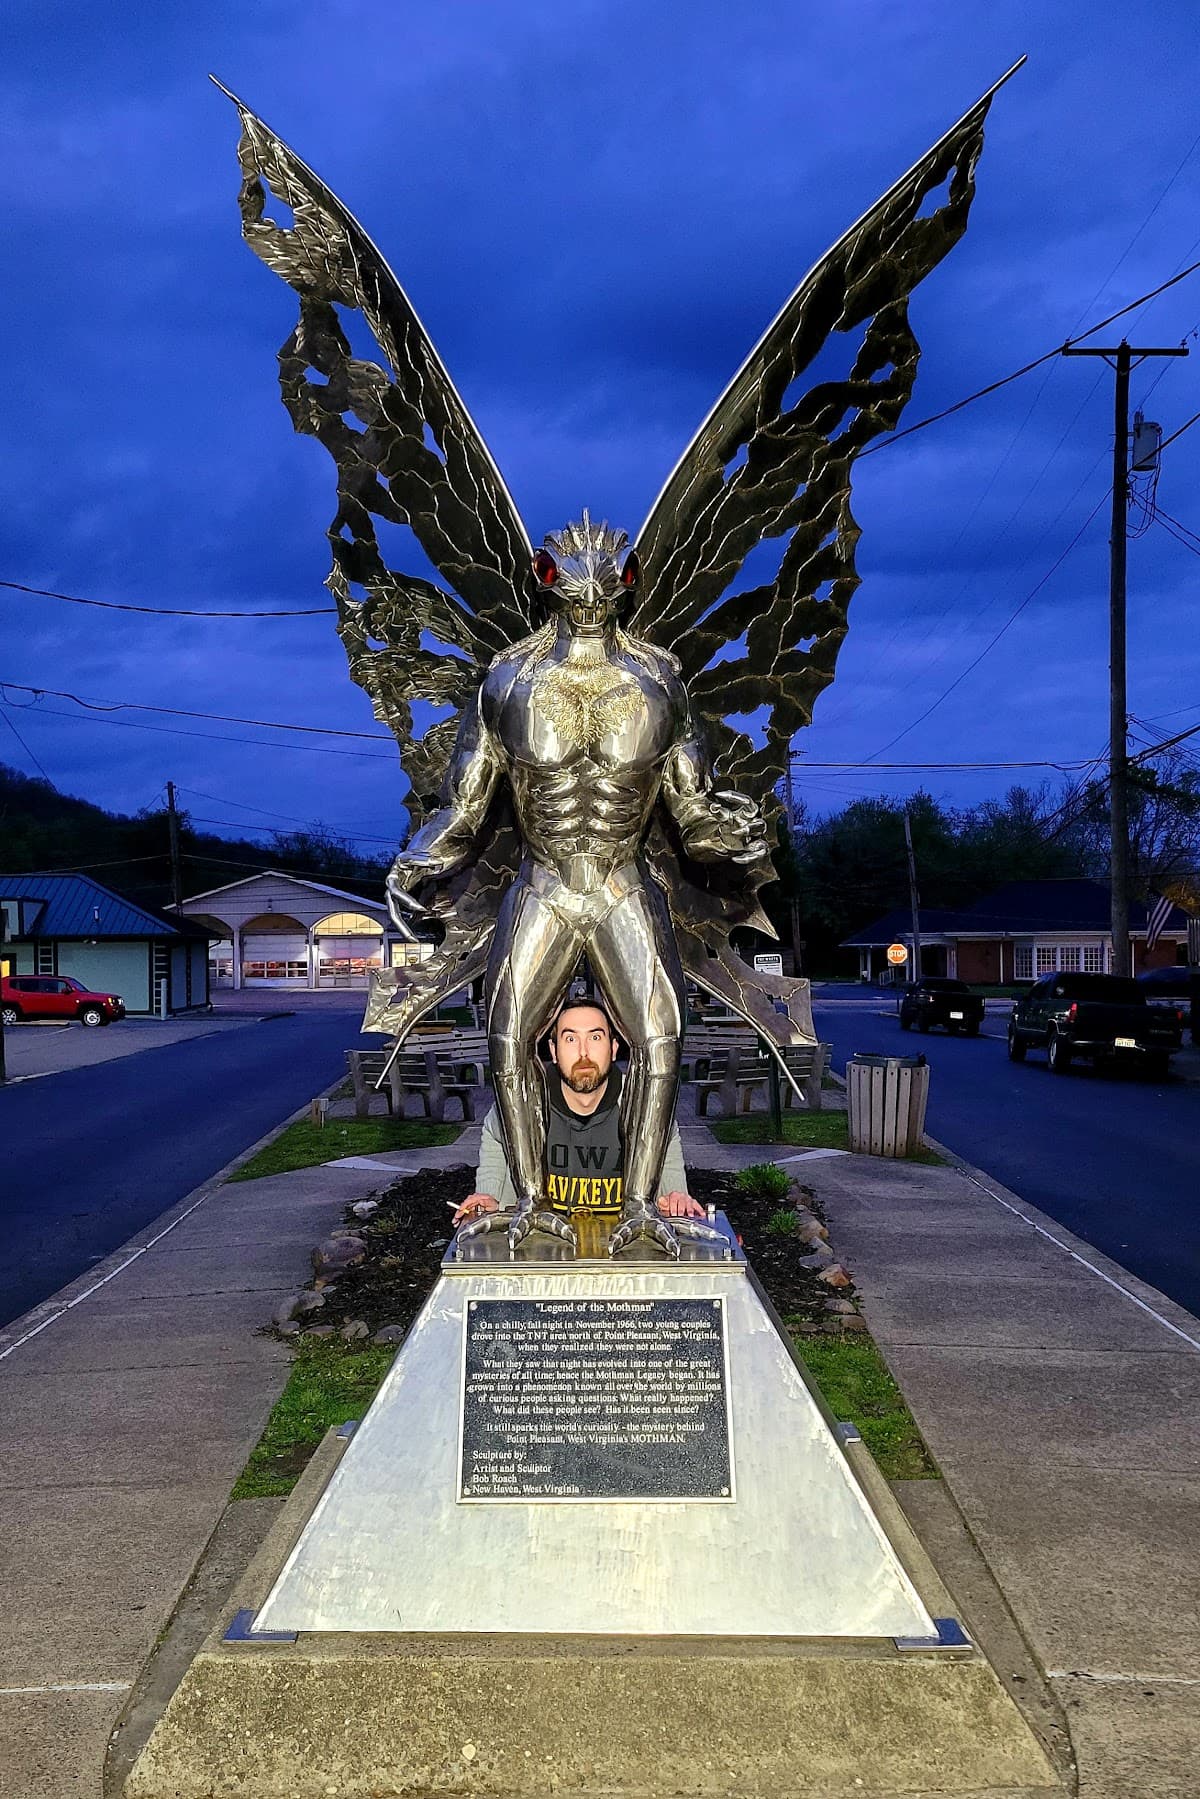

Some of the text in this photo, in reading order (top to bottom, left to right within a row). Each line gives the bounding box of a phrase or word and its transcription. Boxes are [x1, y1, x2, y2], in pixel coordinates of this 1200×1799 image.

[889, 949, 905, 957] STOP
[536, 1302, 654, 1314] "Legend of the Mothman"
[480, 1322, 493, 1330] On
[528, 1320, 540, 1329] fall
[543, 1320, 563, 1330] night
[564, 1320, 572, 1328] in
[576, 1320, 615, 1328] November
[617, 1320, 637, 1329] 1966,
[656, 1322, 679, 1330] young
[681, 1320, 710, 1330] couples
[472, 1332, 493, 1340] drove
[495, 1332, 510, 1340] into
[513, 1332, 525, 1340] the
[528, 1332, 548, 1340] TNT
[570, 1332, 590, 1340] north
[593, 1332, 602, 1340] of
[605, 1332, 624, 1340] Point
[662, 1332, 681, 1340] West
[684, 1331, 720, 1341] Virginia,
[518, 1343, 538, 1351] when
[542, 1343, 558, 1352] they
[562, 1342, 593, 1351] realized
[597, 1342, 613, 1352] they
[483, 1360, 504, 1368] What
[506, 1360, 523, 1370] they
[543, 1360, 560, 1368] that
[560, 1360, 580, 1370] night
[583, 1360, 596, 1368] has
[598, 1360, 627, 1368] evolved
[630, 1360, 645, 1368] into
[664, 1359, 673, 1368] of
[675, 1359, 688, 1368] the
[690, 1360, 710, 1369] great
[472, 1372, 510, 1382] mysteries
[512, 1372, 520, 1380] of
[521, 1371, 532, 1380] all
[557, 1371, 579, 1380] hence
[582, 1370, 595, 1379] the
[597, 1370, 634, 1379] Mothman
[637, 1370, 666, 1380] Legacy
[669, 1370, 695, 1380] began.
[698, 1370, 704, 1379] It
[705, 1370, 720, 1379] has
[466, 1384, 494, 1392] grown
[497, 1382, 513, 1391] into
[523, 1383, 572, 1392] phenomenon
[575, 1382, 602, 1390] known
[605, 1382, 615, 1390] all
[634, 1382, 648, 1390] the
[650, 1382, 672, 1390] world
[675, 1382, 687, 1392] by
[688, 1382, 721, 1390] millions
[478, 1394, 487, 1402] of
[489, 1394, 518, 1402] curious
[521, 1394, 546, 1404] people
[549, 1394, 575, 1403] asking
[620, 1394, 643, 1402] What
[644, 1394, 667, 1403] really
[670, 1393, 714, 1402] happened?
[494, 1406, 515, 1414] What
[517, 1405, 530, 1414] did
[533, 1405, 553, 1414] these
[556, 1406, 581, 1415] people
[606, 1405, 621, 1413] Has
[623, 1405, 629, 1413] it
[630, 1405, 650, 1413] been
[674, 1404, 699, 1413] since?
[487, 1424, 493, 1432] It
[494, 1423, 510, 1432] still
[511, 1423, 538, 1432] sparks
[541, 1423, 552, 1431] the
[583, 1422, 619, 1432] curiosity
[627, 1422, 639, 1431] the
[642, 1423, 674, 1432] mystery
[677, 1422, 705, 1430] behind
[507, 1434, 527, 1443] Point
[567, 1434, 586, 1443] West
[473, 1450, 527, 1460] Sculpture by:
[473, 1464, 551, 1474] Artist and Sculptor
[473, 1474, 517, 1482] Bob Roach
[472, 1484, 579, 1494] New Haven, West Virginia
